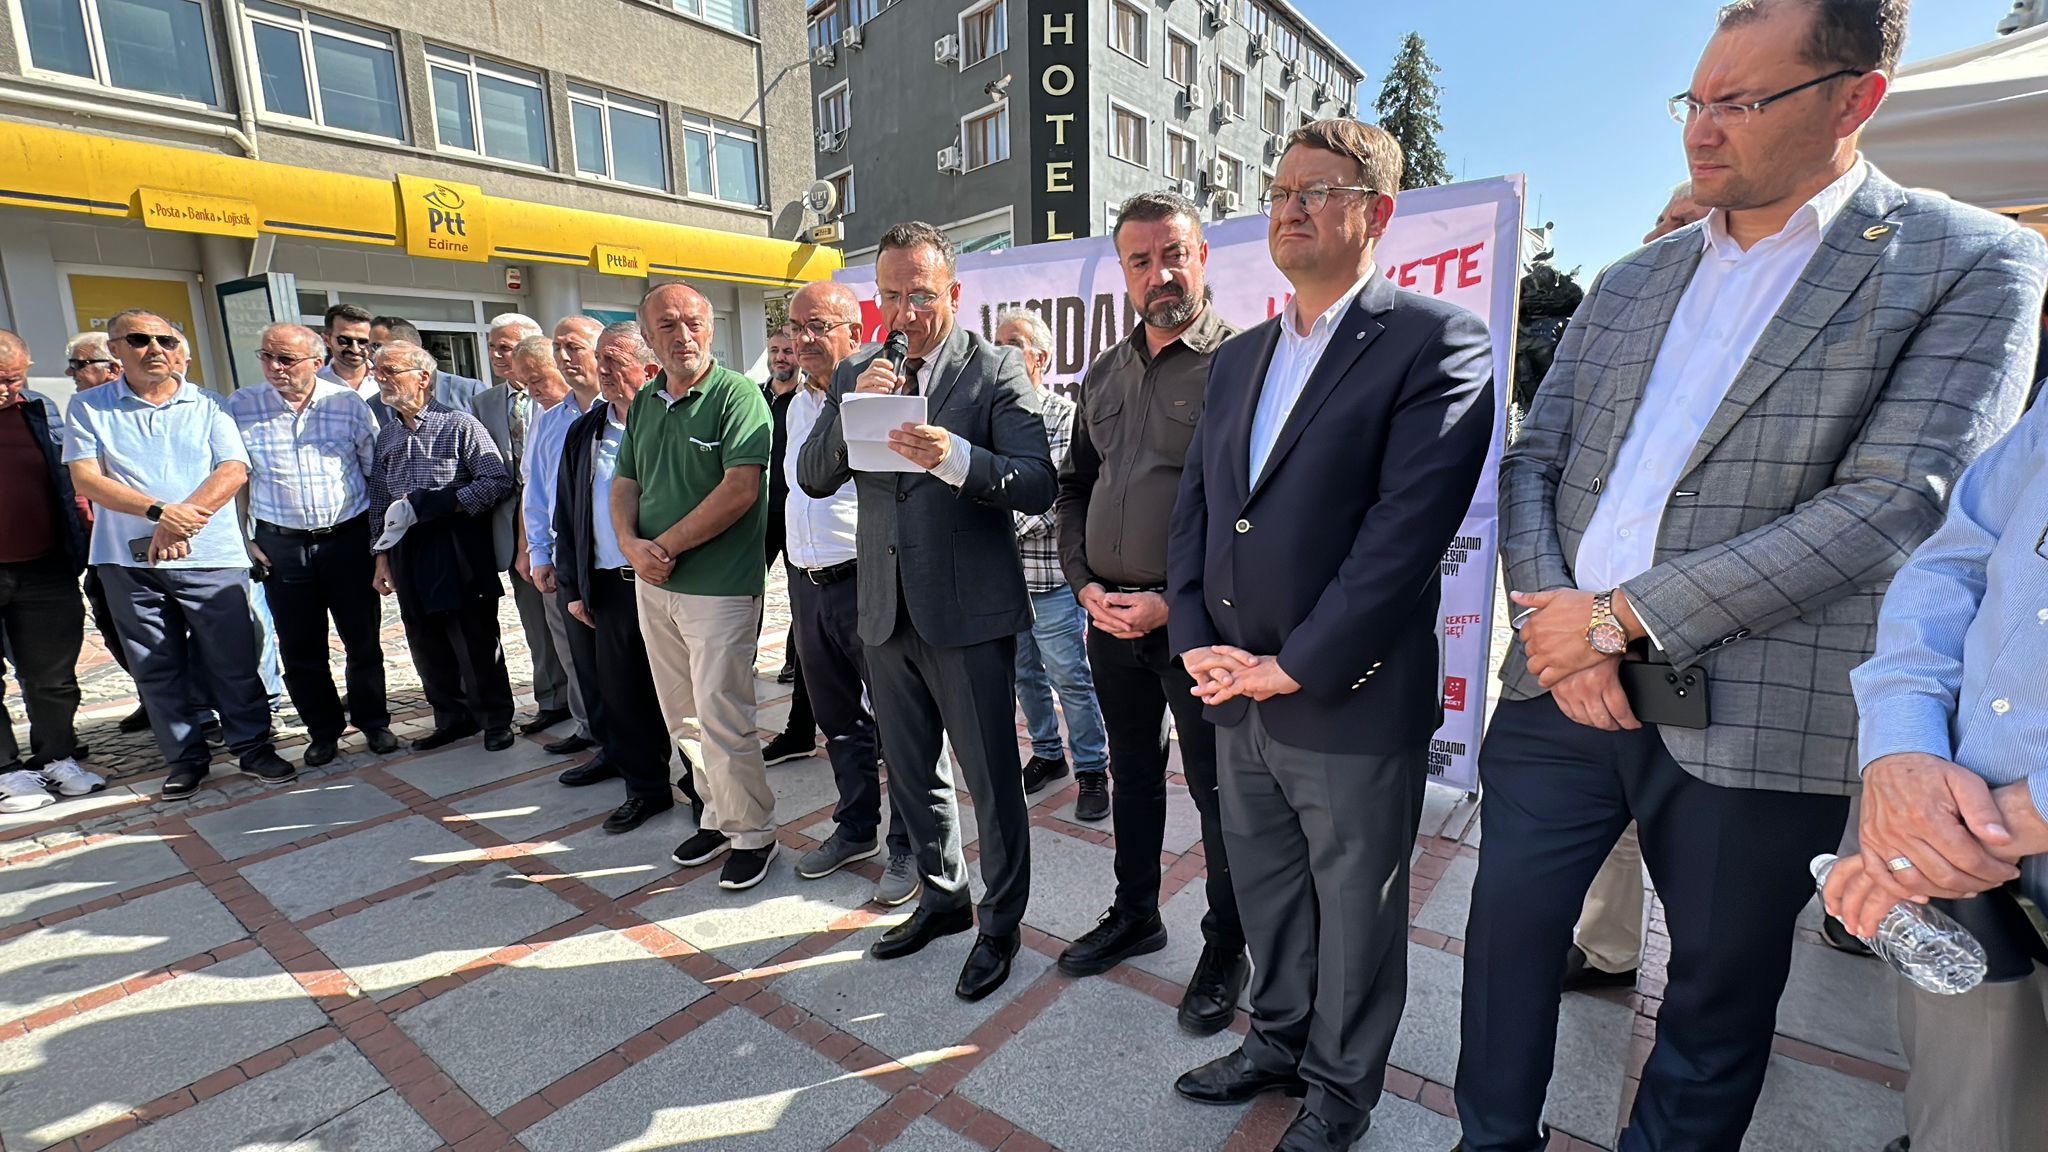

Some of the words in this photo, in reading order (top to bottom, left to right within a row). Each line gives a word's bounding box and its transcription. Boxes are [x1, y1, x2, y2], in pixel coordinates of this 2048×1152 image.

[1042, 13, 1075, 240] HOTEL
[155, 203, 181, 218] Posta
[187, 206, 216, 222] Banka
[428, 207, 466, 236] Ptt
[428, 237, 469, 252] Edirne
